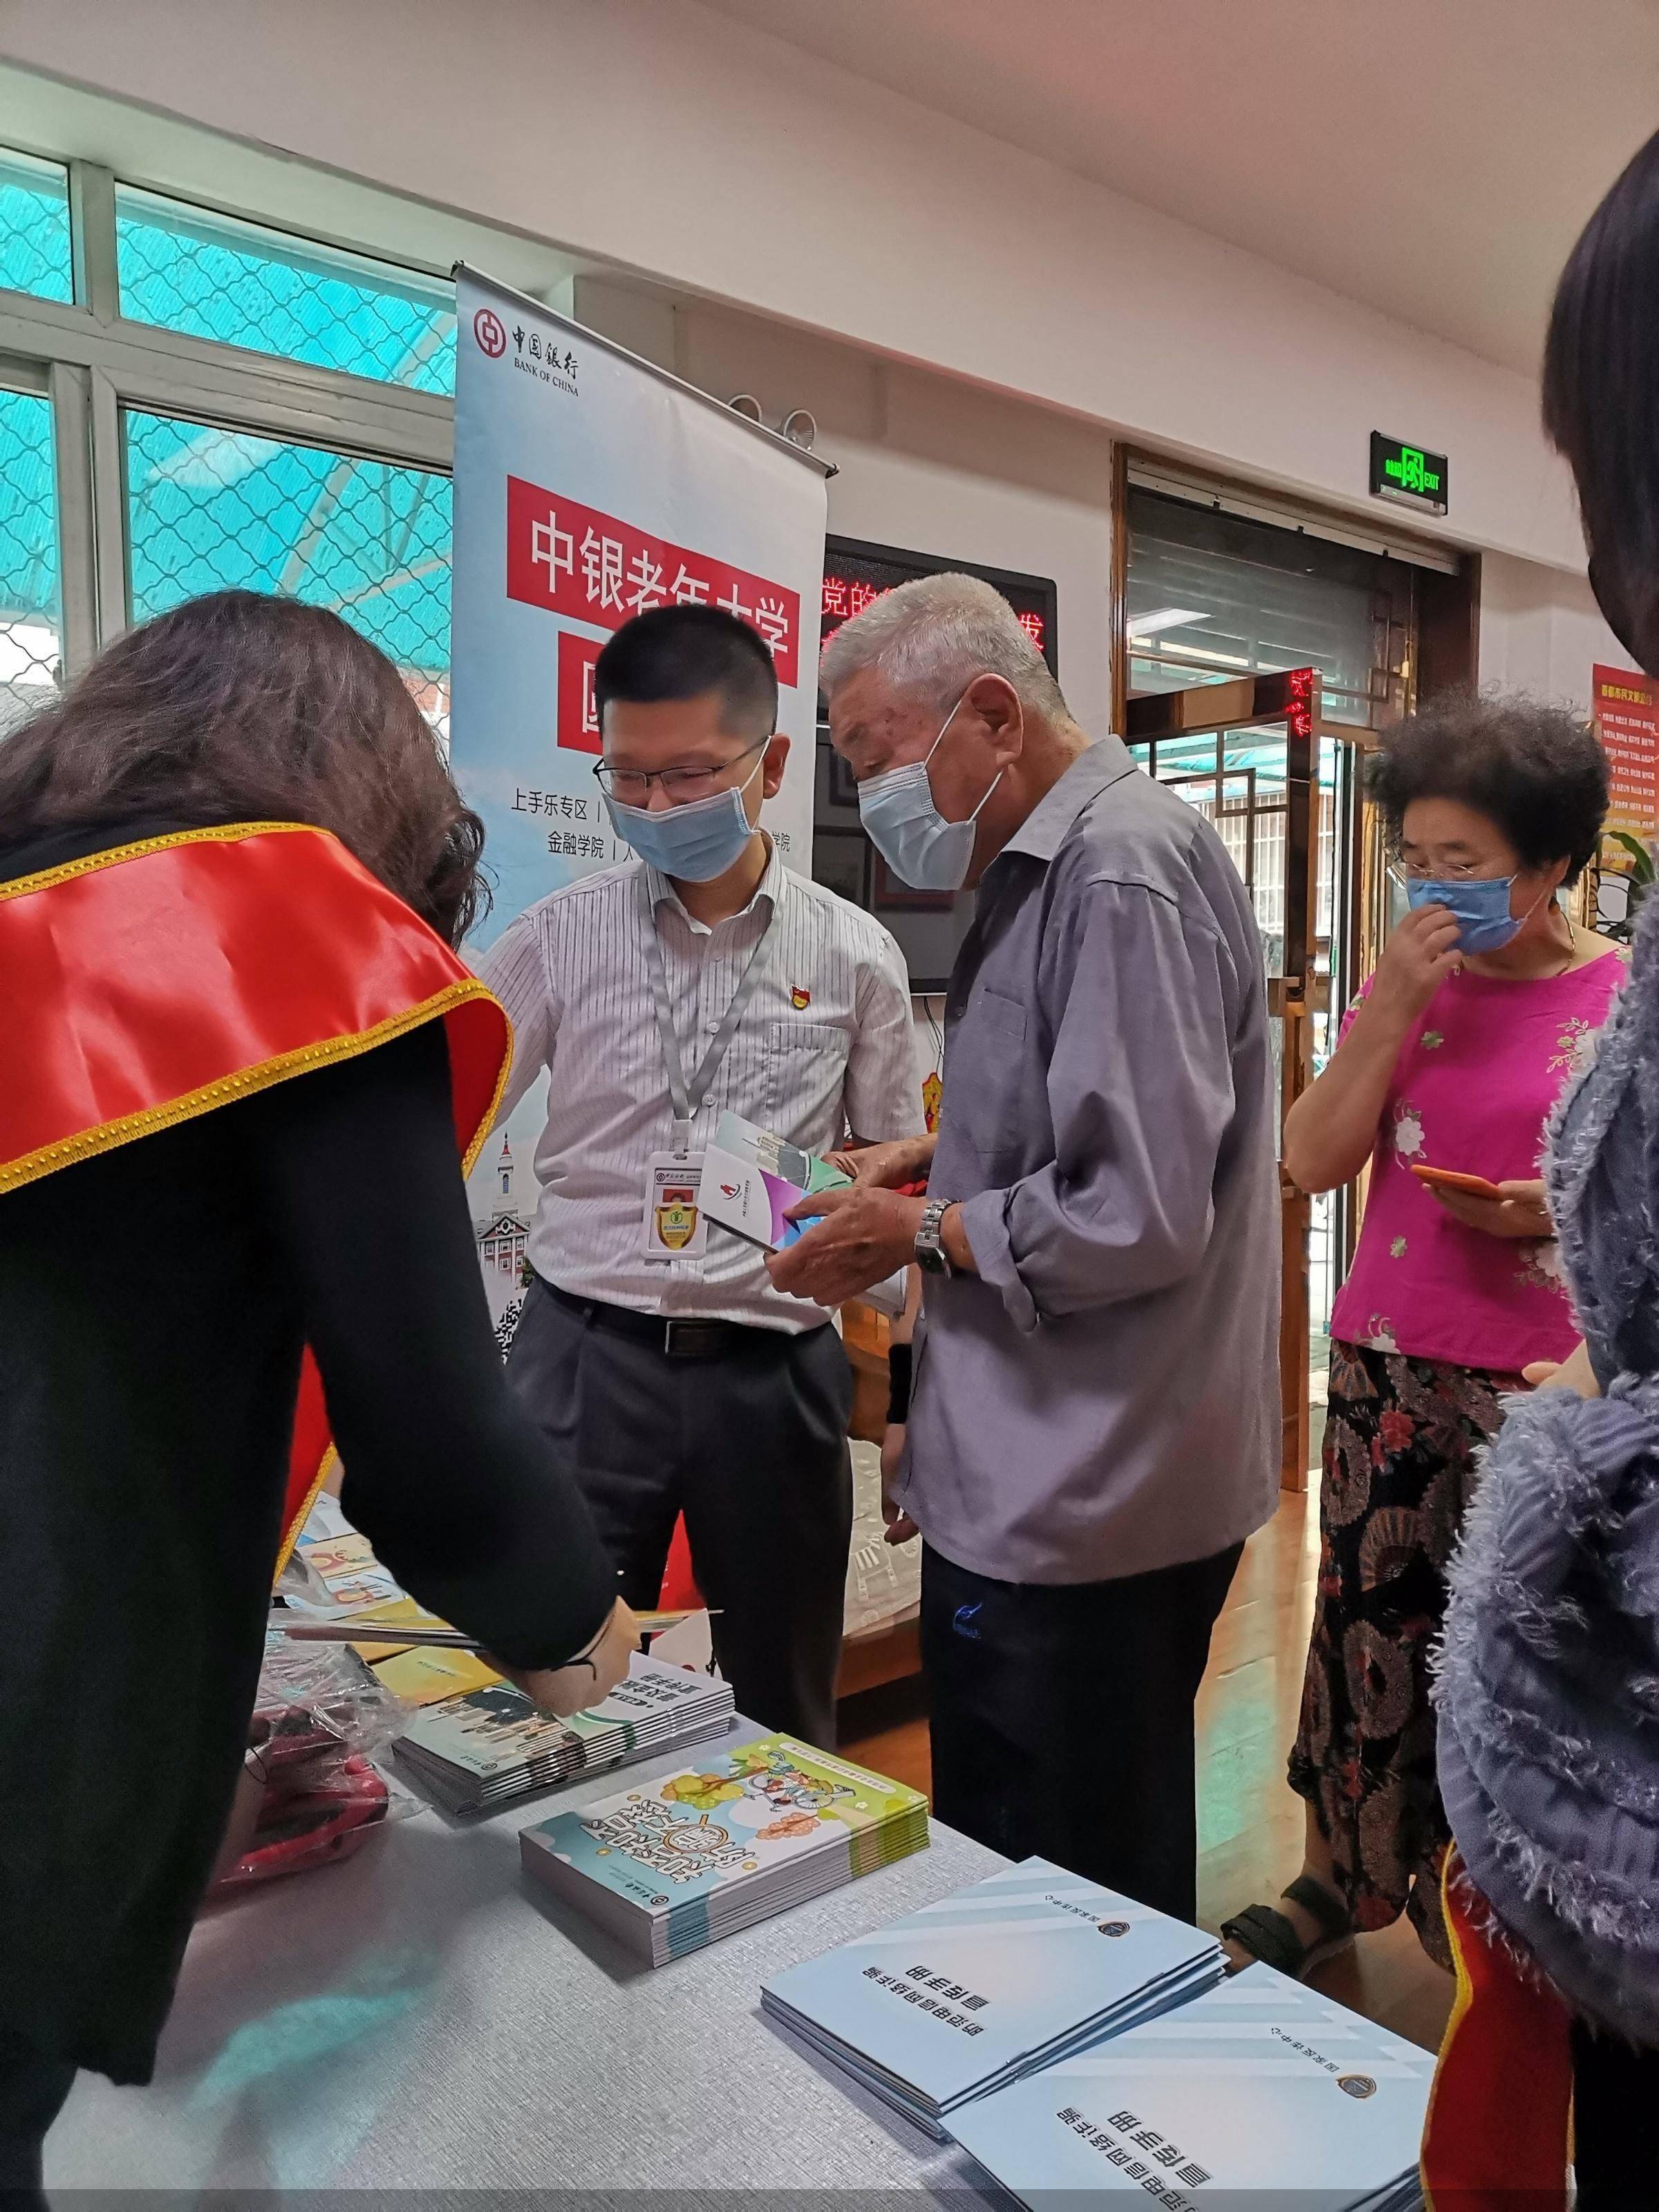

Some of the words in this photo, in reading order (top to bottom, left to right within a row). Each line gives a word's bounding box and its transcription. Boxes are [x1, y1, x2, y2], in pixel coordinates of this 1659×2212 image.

[512, 326, 579, 379] 中国银行
[514, 357, 538, 377] BANK
[540, 370, 551, 382] OF
[552, 376, 579, 397] CHINA
[1425, 472, 1439, 491] EXIT
[511, 787, 588, 821] 上手乐专区
[547, 830, 604, 859] 金融学院
[579, 1813, 714, 1884] 知否知否
[861, 1966, 986, 2037] 防范电信网络诈骗
[904, 1965, 991, 2012] 宣传手册
[1271, 2027, 1340, 2073] 国家反诈中心
[1055, 2107, 1200, 2212] 范电信网络诈骗
[1106, 2110, 1212, 2189] 宣传手册
